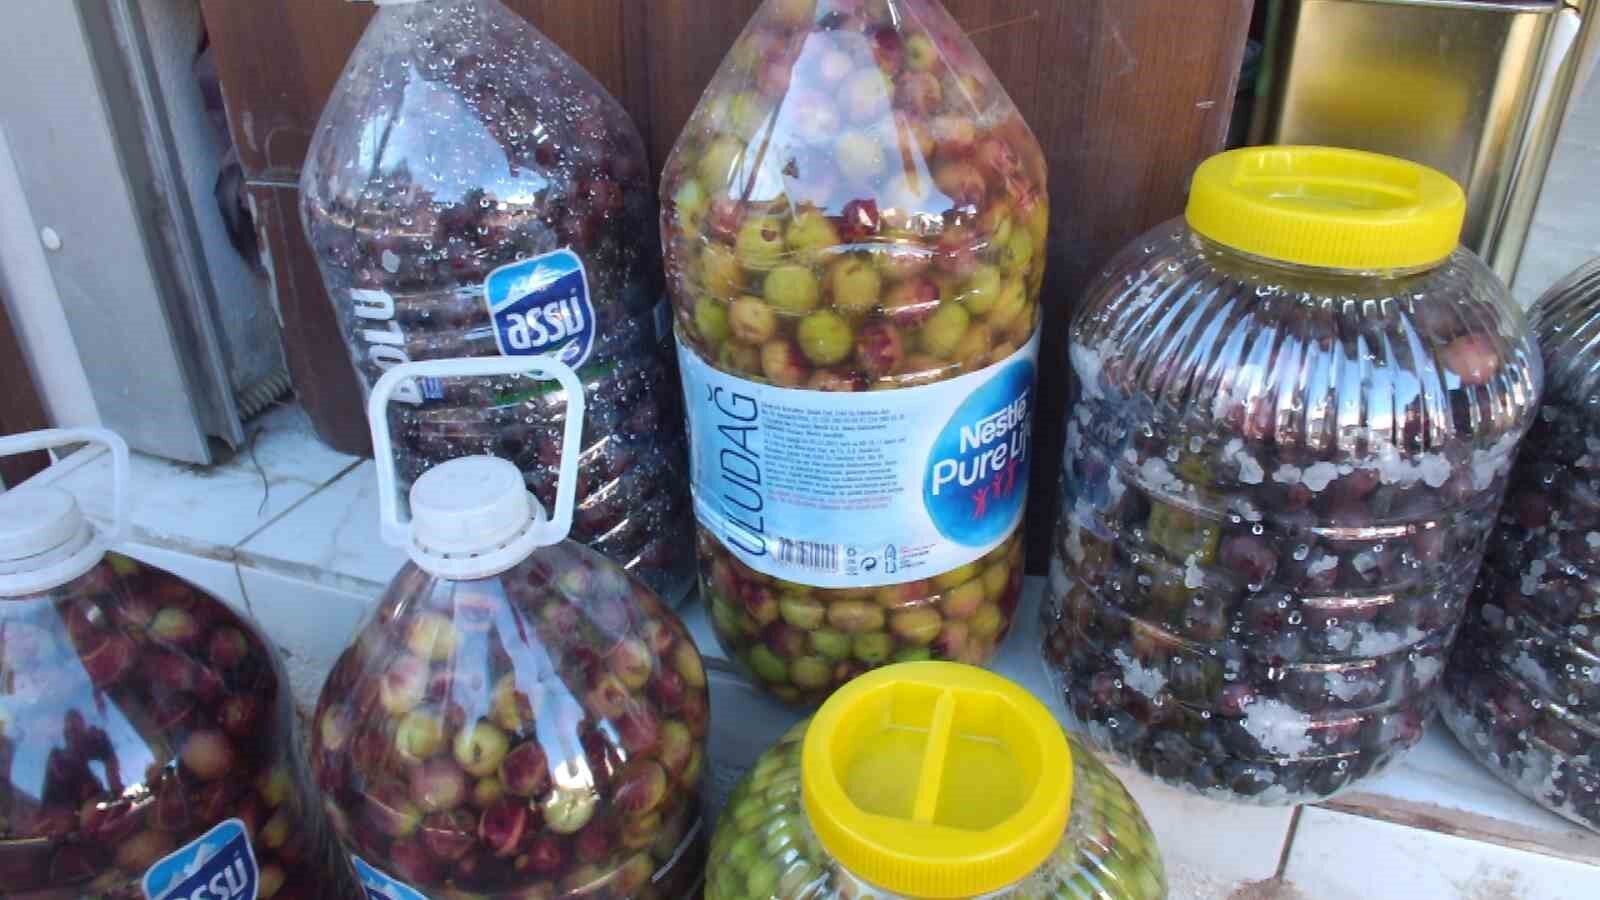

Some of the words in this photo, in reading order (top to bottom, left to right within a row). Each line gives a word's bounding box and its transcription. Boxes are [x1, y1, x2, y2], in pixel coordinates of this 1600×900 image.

[959, 387, 1029, 454] Nestlé
[706, 385, 766, 557] ULUDAĞ
[932, 442, 1008, 497] Pure
